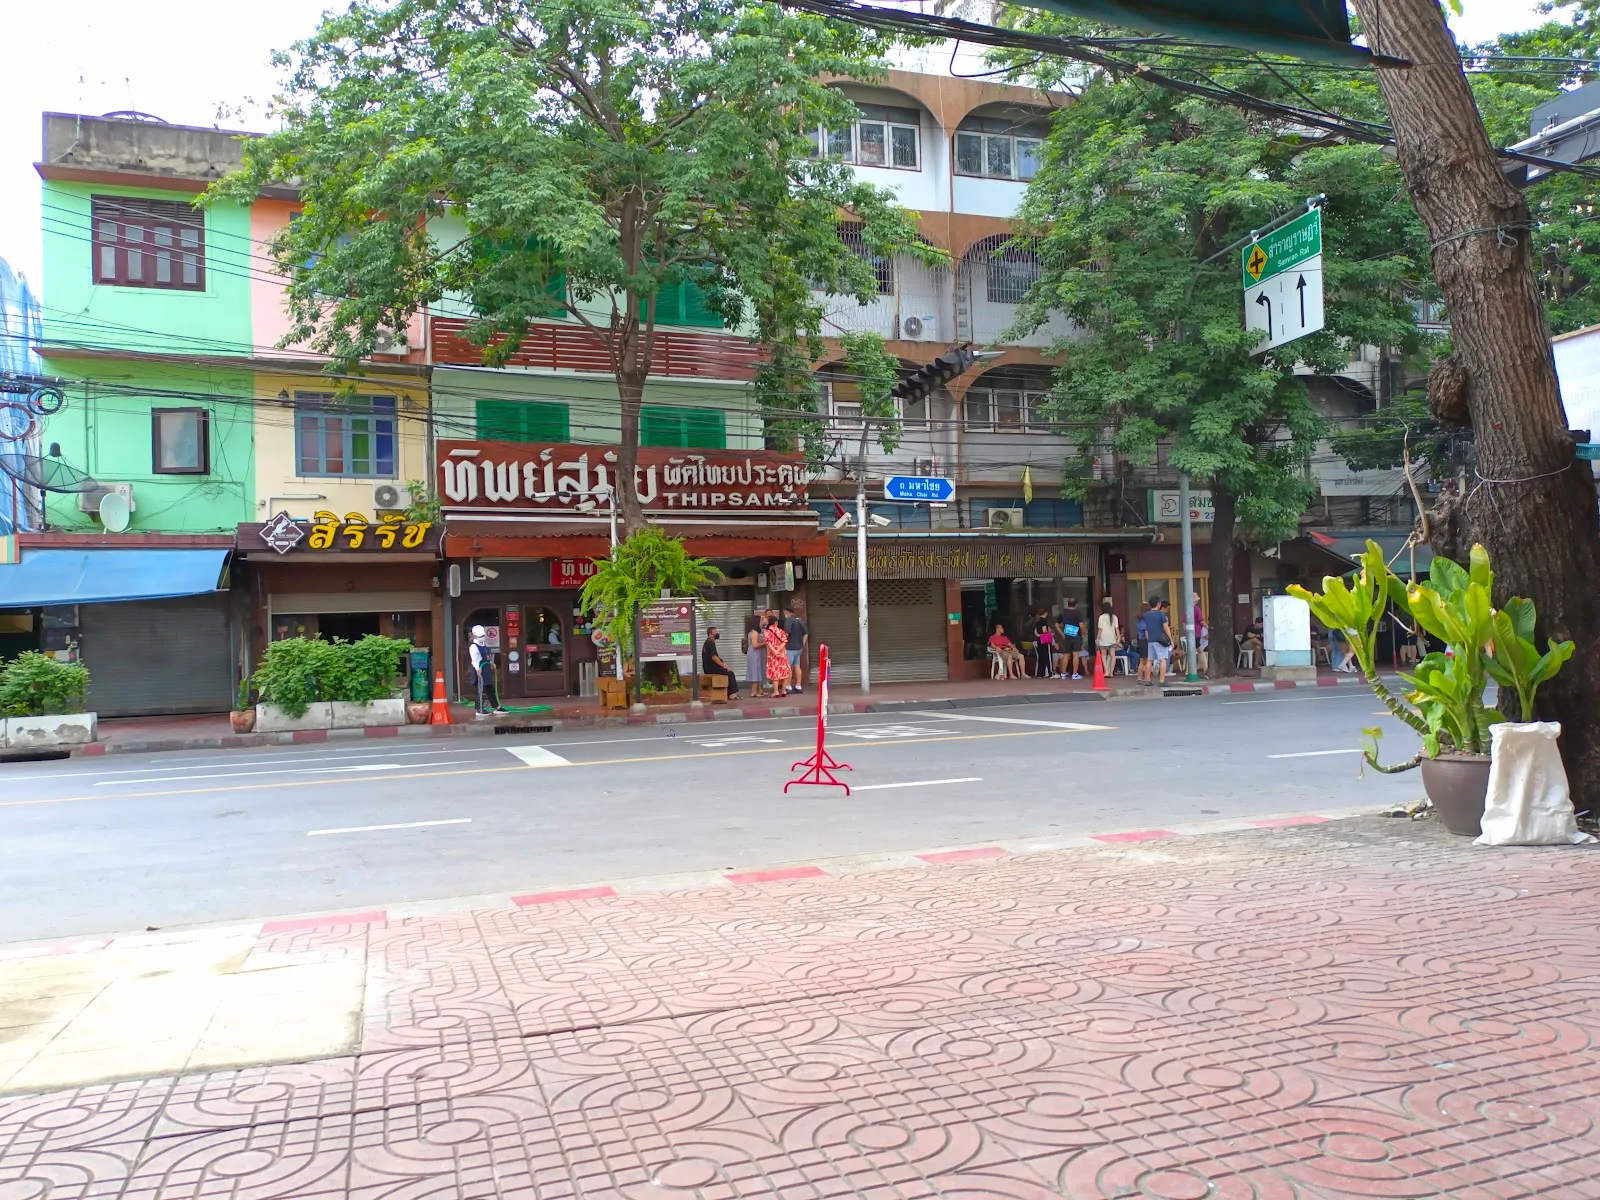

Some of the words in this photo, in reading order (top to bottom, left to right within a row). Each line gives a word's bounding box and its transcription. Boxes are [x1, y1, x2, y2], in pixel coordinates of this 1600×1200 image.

[1268, 215, 1319, 259] สำราญราษฎร์
[1277, 253, 1298, 267] Samran
[1299, 246, 1310, 258] Rat
[908, 479, 940, 492] มหาไชย
